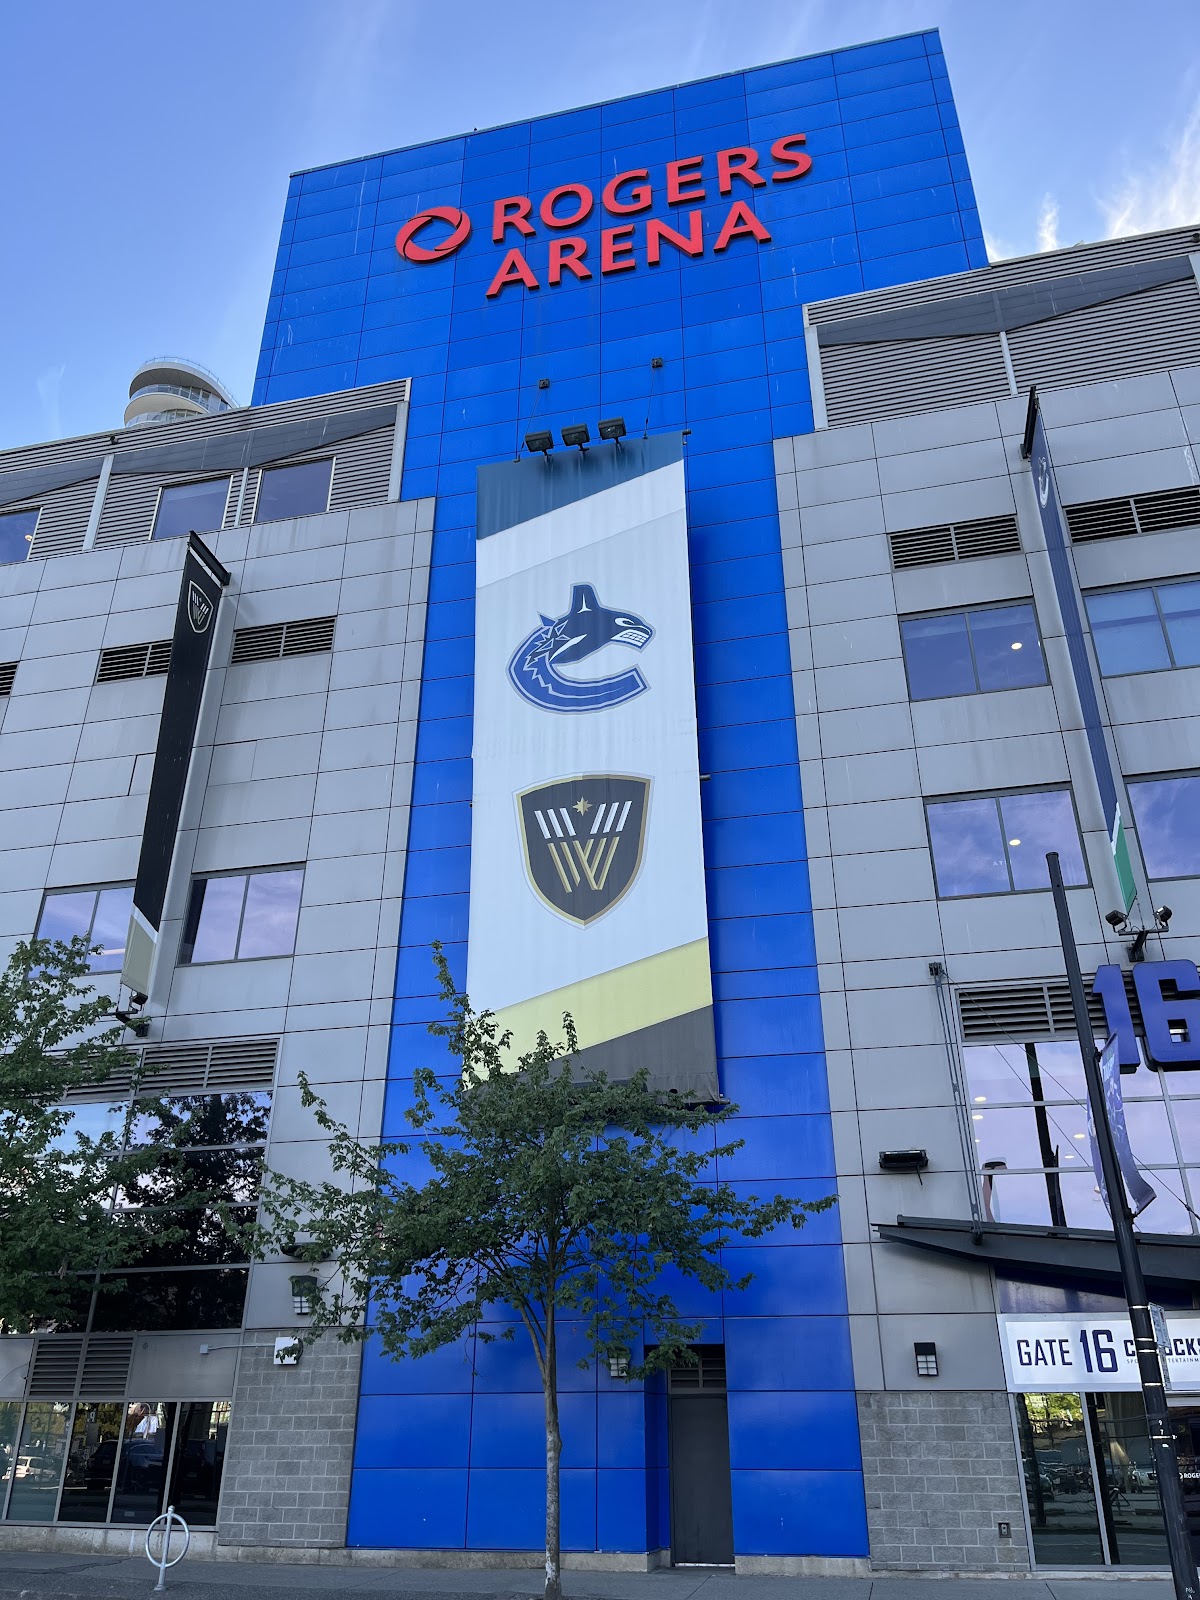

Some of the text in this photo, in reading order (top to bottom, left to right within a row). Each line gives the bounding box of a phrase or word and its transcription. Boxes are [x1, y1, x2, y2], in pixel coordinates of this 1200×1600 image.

[492, 133, 813, 243] ROGERS
[485, 200, 772, 298] ARENA
[1092, 959, 1200, 1067] 16
[1016, 1339, 1073, 1366] GATE
[1080, 1329, 1119, 1373] 16
